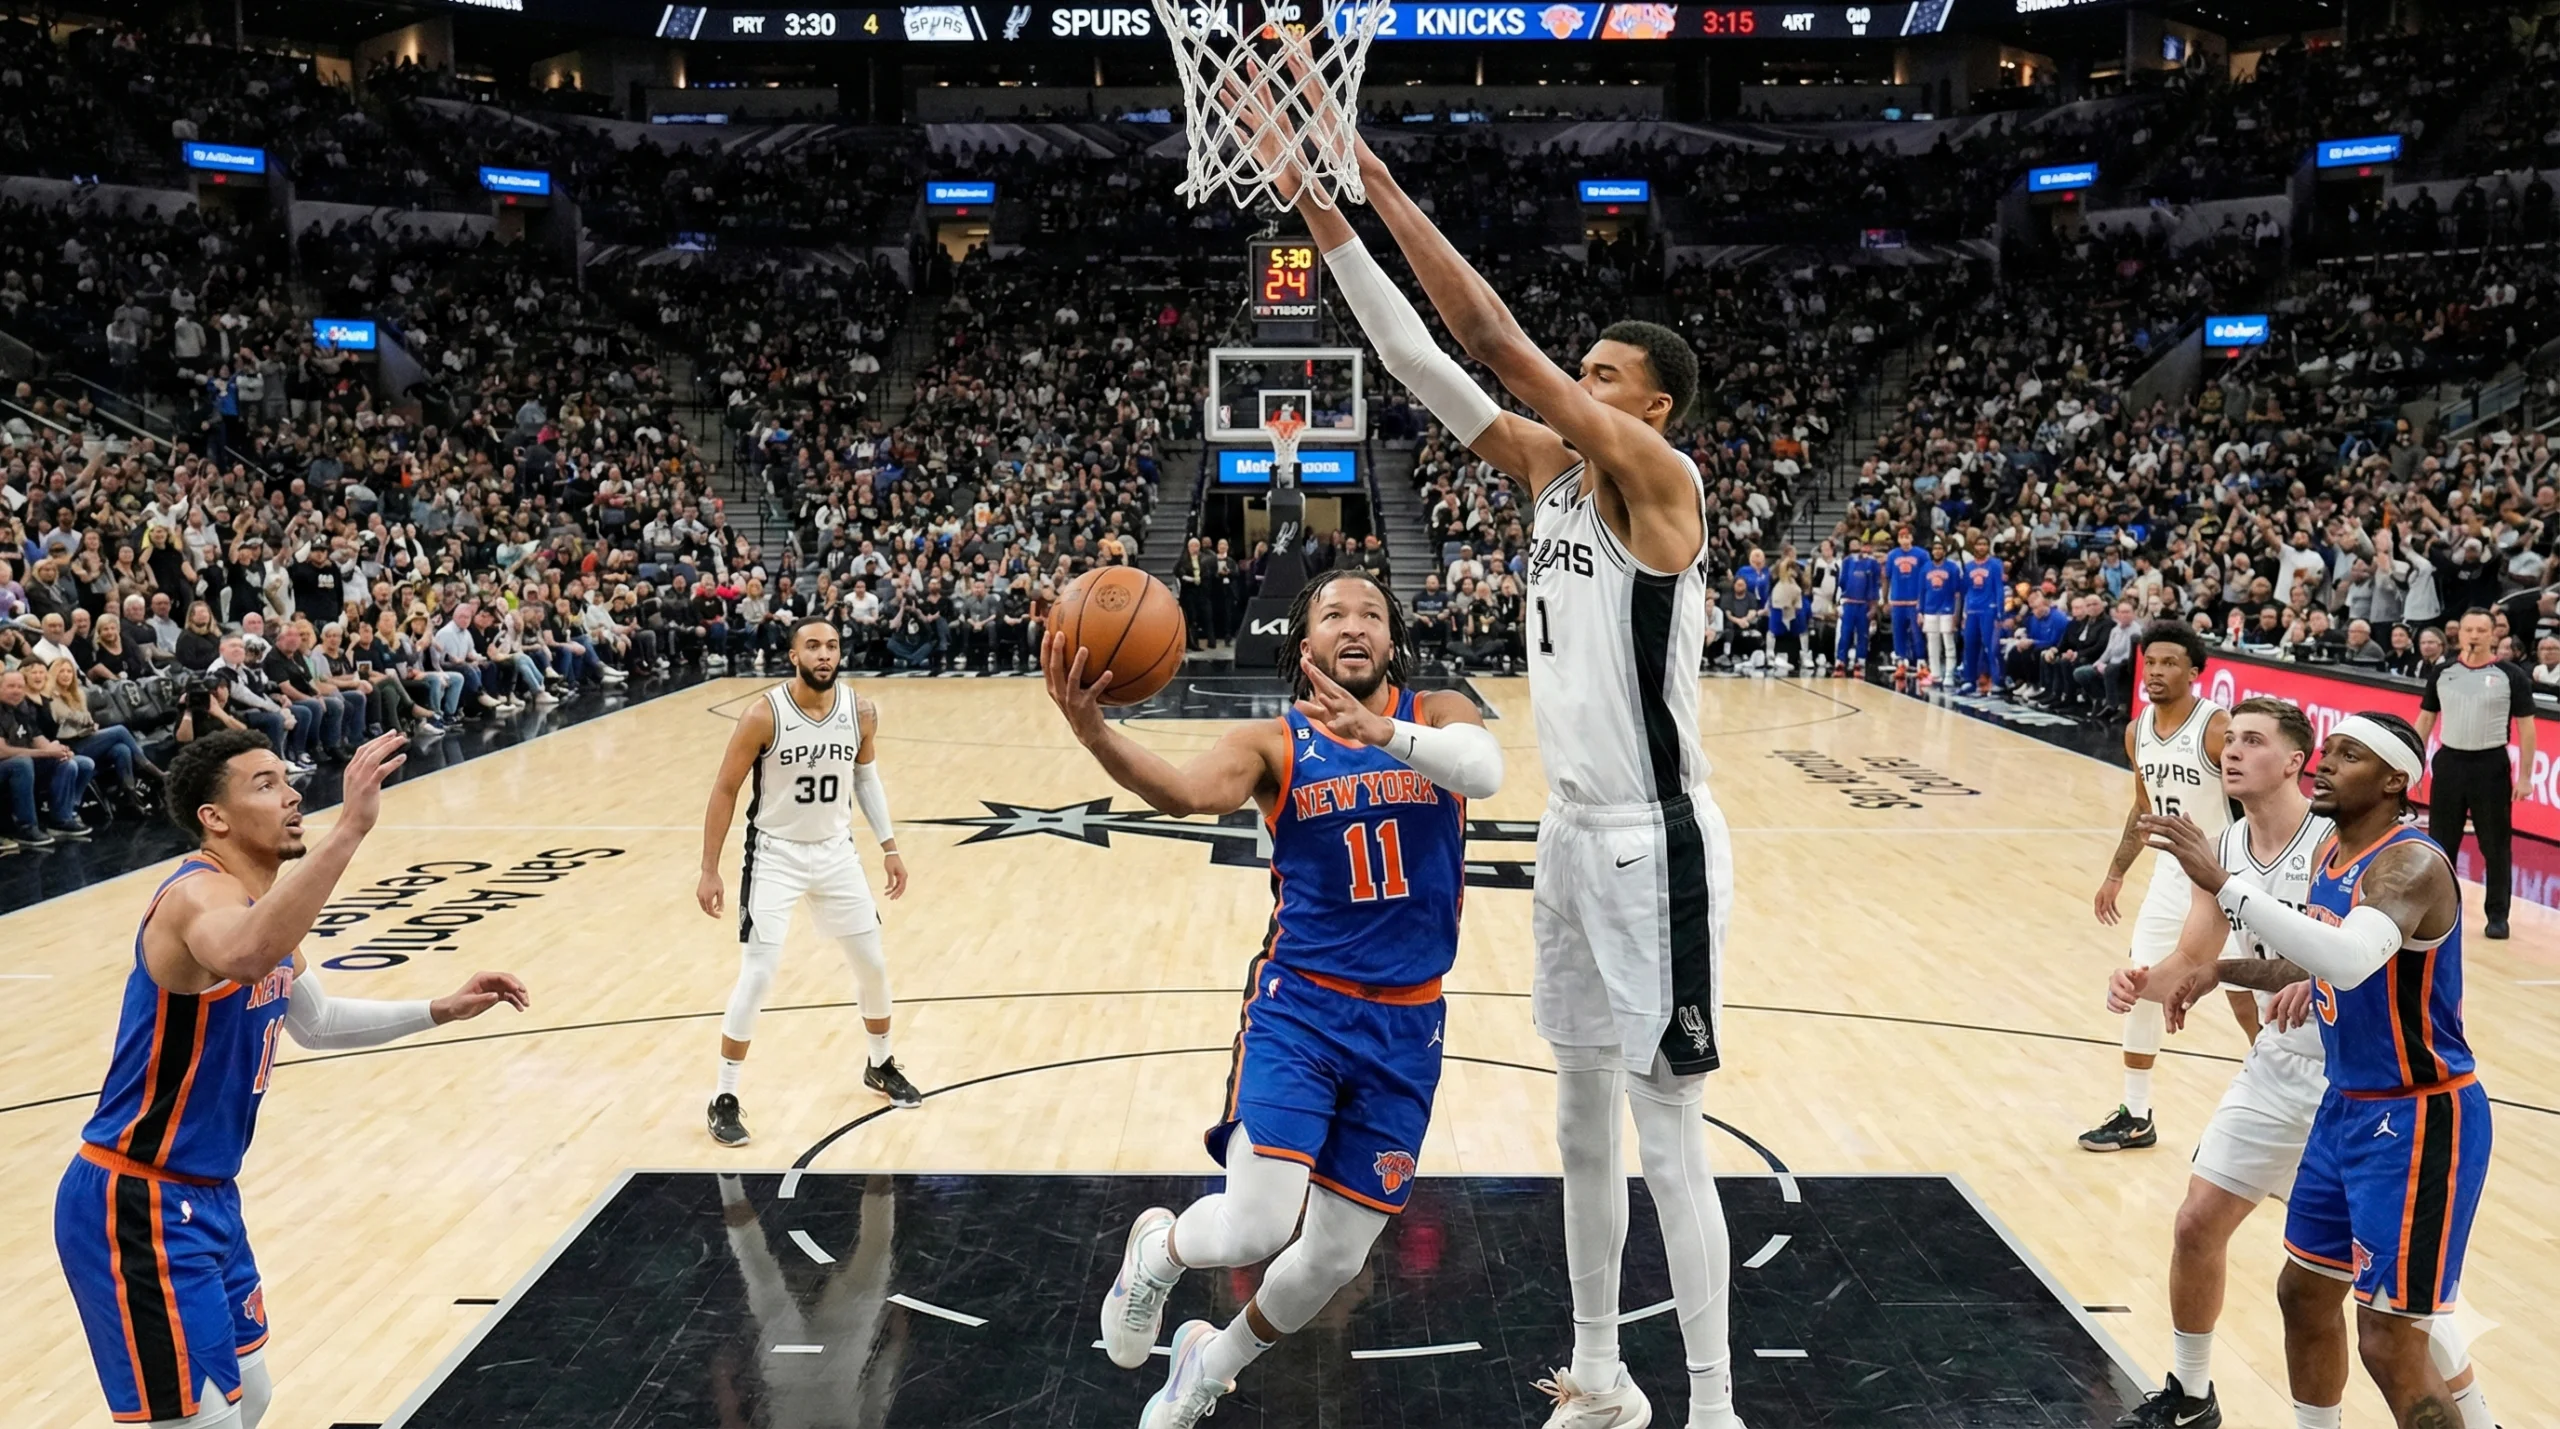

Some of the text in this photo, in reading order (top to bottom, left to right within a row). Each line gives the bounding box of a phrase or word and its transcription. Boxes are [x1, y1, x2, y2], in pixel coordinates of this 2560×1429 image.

[732, 13, 879, 36] PRY 3:30 4
[1051, 8, 1151, 37] SPURS
[1416, 8, 1526, 36] KNICKS
[1702, 10, 1755, 34] 3:15
[1271, 248, 1311, 269] 5:30
[1266, 269, 1306, 300] 24
[1536, 596, 1555, 657] 1
[780, 743, 855, 769] SPURS
[795, 775, 838, 804] 30
[1292, 769, 1439, 822] NEW YORK
[486, 847, 626, 883] San
[1343, 817, 1410, 903] 11
